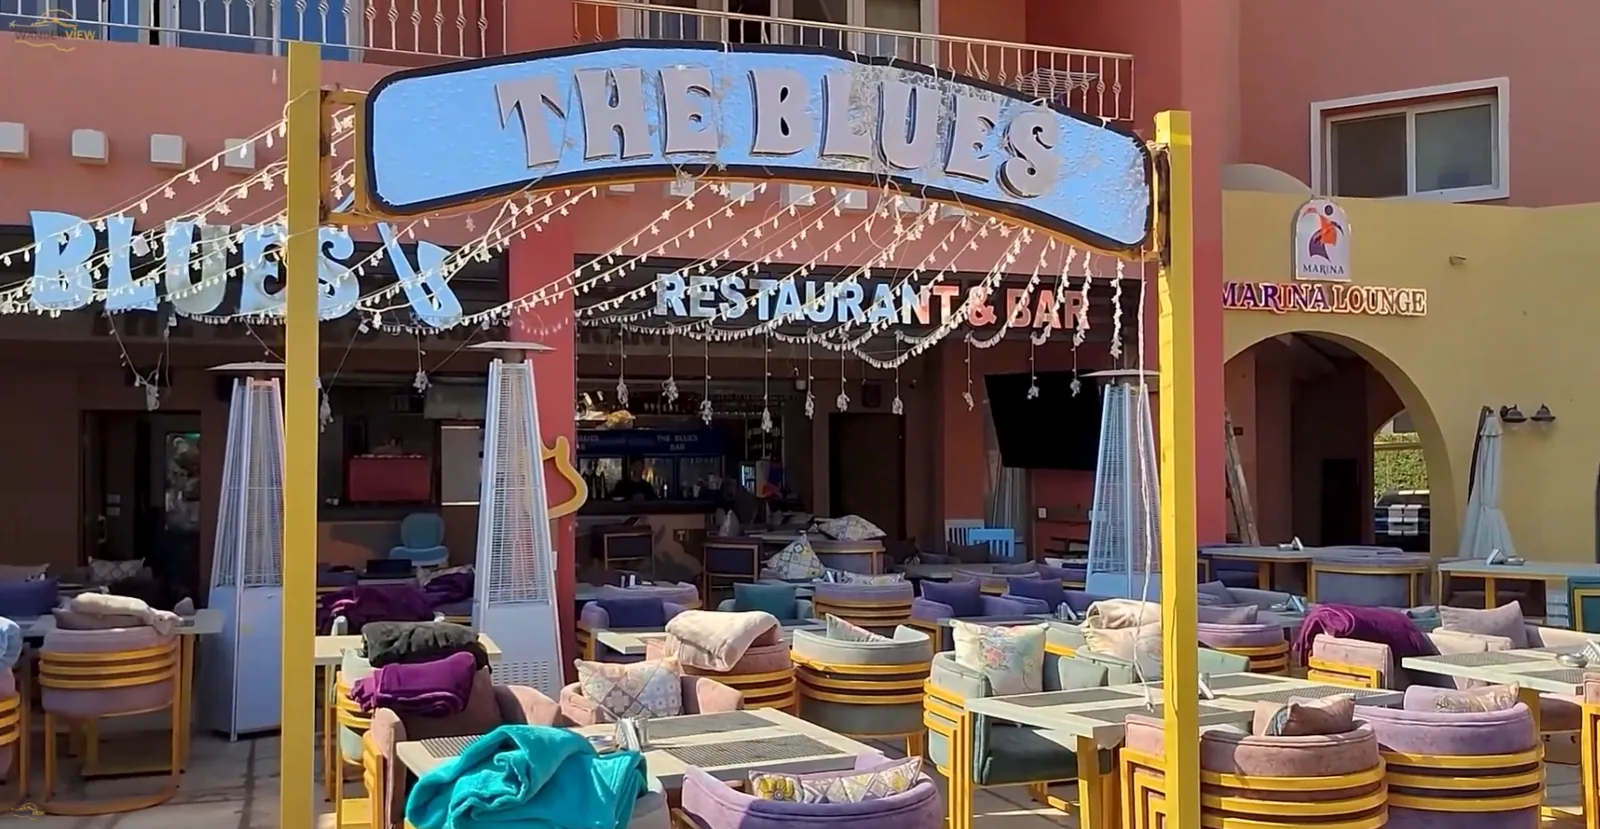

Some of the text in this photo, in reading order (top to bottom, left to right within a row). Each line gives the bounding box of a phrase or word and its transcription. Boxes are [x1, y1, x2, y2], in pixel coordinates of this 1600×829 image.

[494, 65, 1060, 199] THE BLUES
[30, 211, 360, 318] BLUES
[1302, 263, 1345, 275] MARINA
[655, 273, 1091, 329] RESTAURANT & BAR
[1223, 282, 1427, 316] MARINA LOUNGE
[656, 434, 698, 443] THE BLUES
[669, 443, 686, 451] BAR
